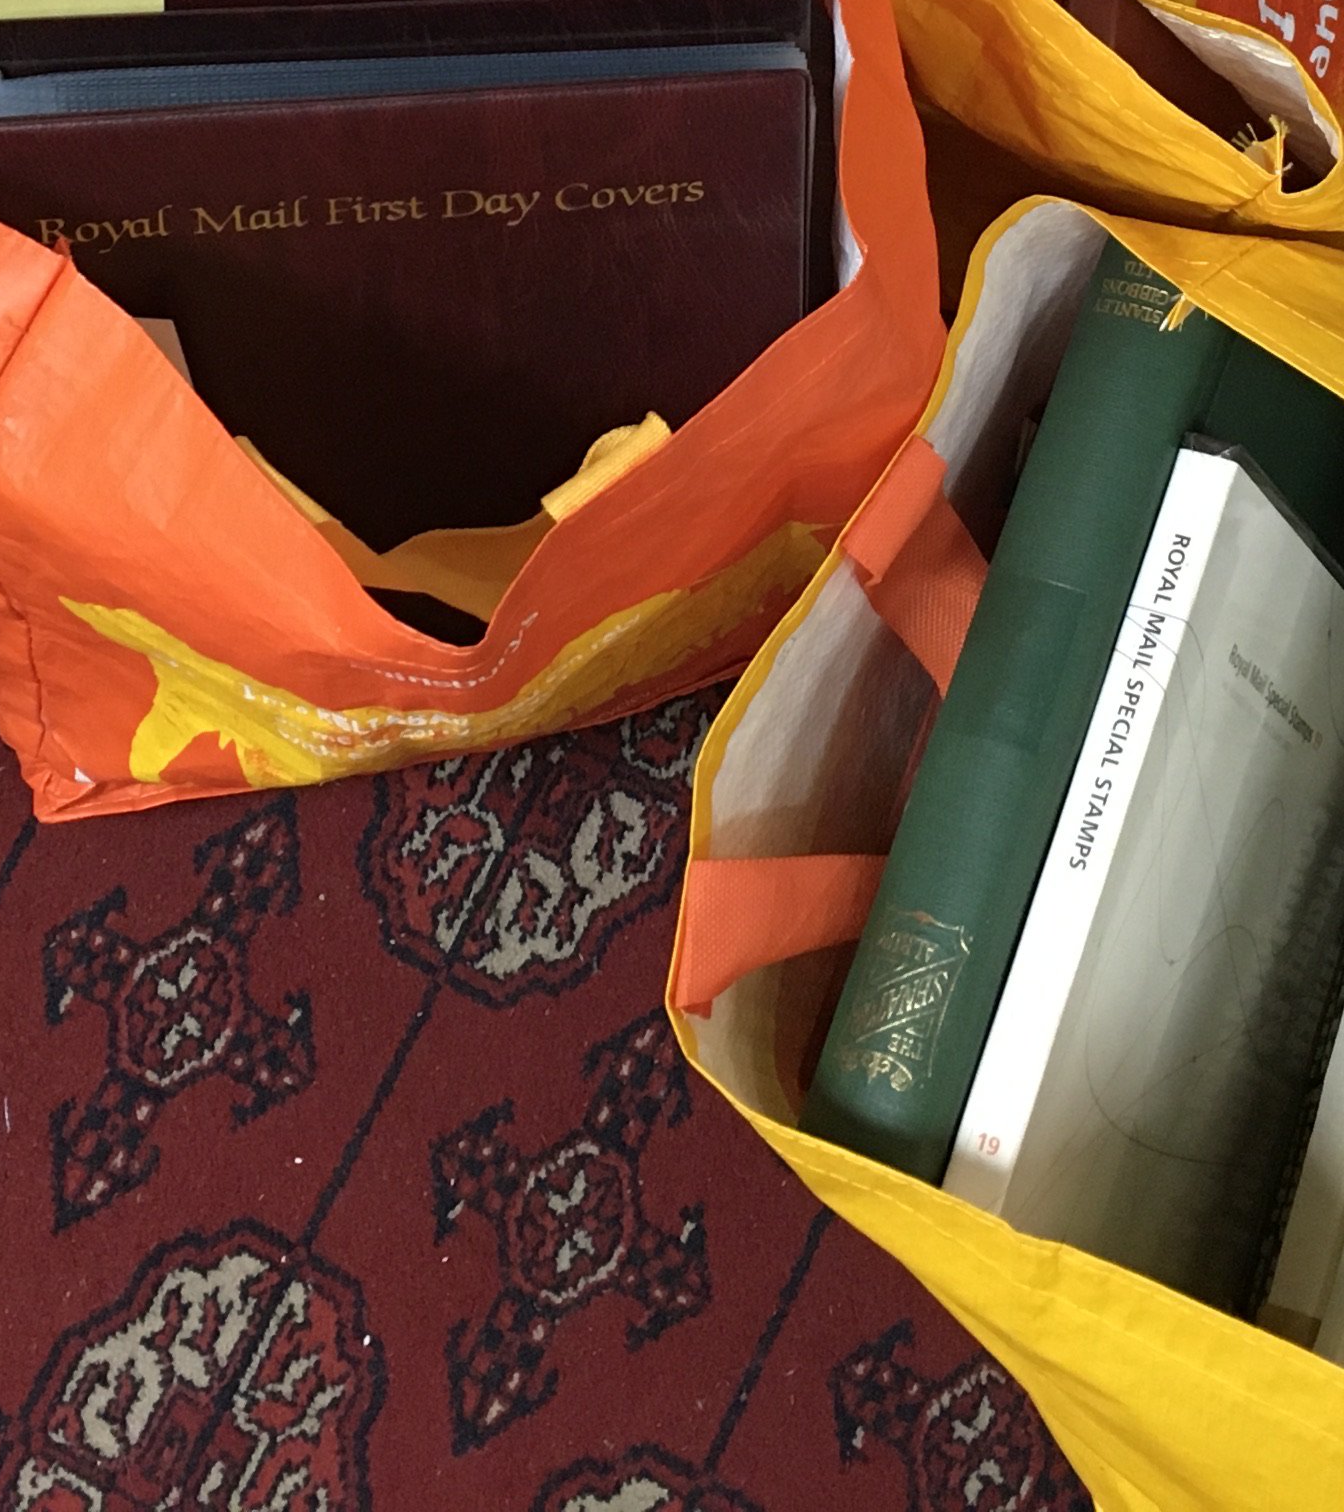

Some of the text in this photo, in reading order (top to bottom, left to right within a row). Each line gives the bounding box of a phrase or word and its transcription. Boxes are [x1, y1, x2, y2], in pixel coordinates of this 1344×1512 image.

[35, 179, 706, 255] Royal Mail First Day Covers
[1101, 277, 1170, 307] GIBBONS
[1093, 297, 1164, 325] STANLEY
[1069, 533, 1192, 872] ROYAL MAIL SPECIAL STAMPS
[1227, 643, 1252, 680] Royal
[1249, 663, 1269, 694] Mail
[1265, 681, 1293, 722] Special
[1288, 705, 1315, 744] Stamps
[887, 1033, 924, 1062] THE
[976, 1132, 1001, 1157] 19
